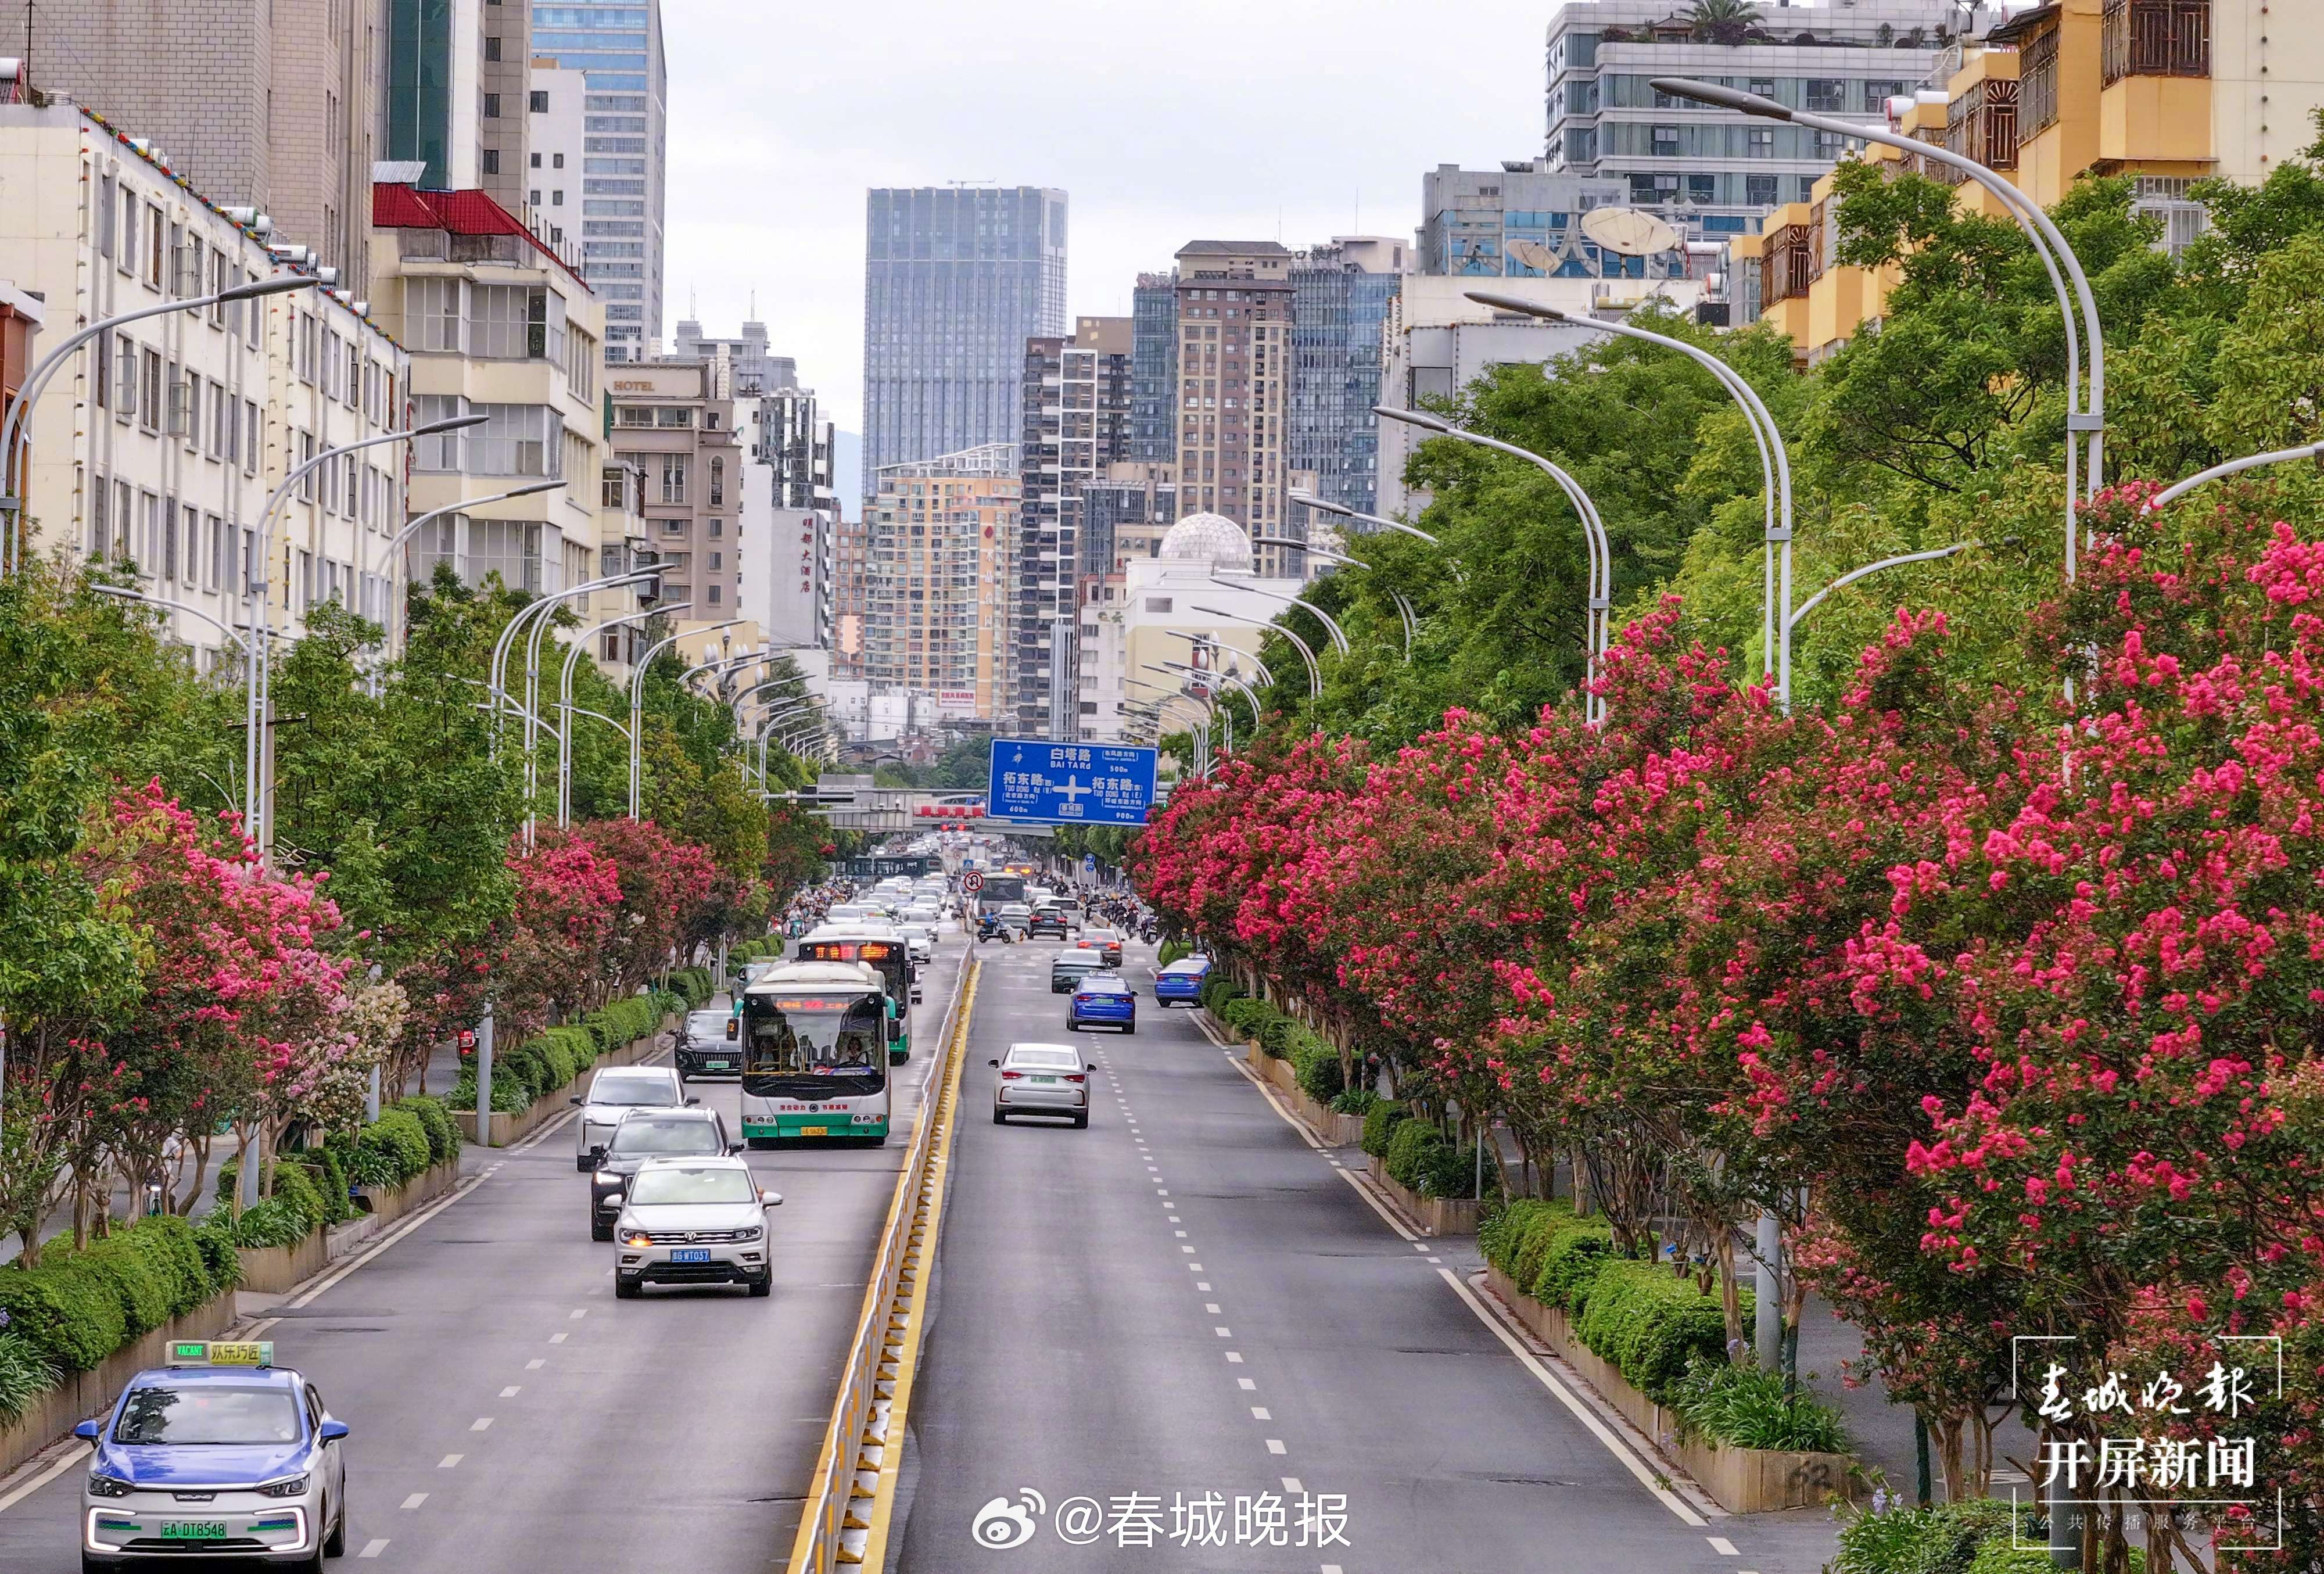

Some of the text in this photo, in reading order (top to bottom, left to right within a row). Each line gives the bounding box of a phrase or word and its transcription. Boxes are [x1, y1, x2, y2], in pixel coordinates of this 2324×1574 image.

[1288, 246, 1343, 263] 口银行
[614, 381, 655, 390] HOTEL
[801, 518, 813, 593] 明都大酒店
[1050, 748, 1091, 761] 白塔路
[177, 1346, 204, 1356] VACANT
[211, 1345, 259, 1360] 欢乐巧匠
